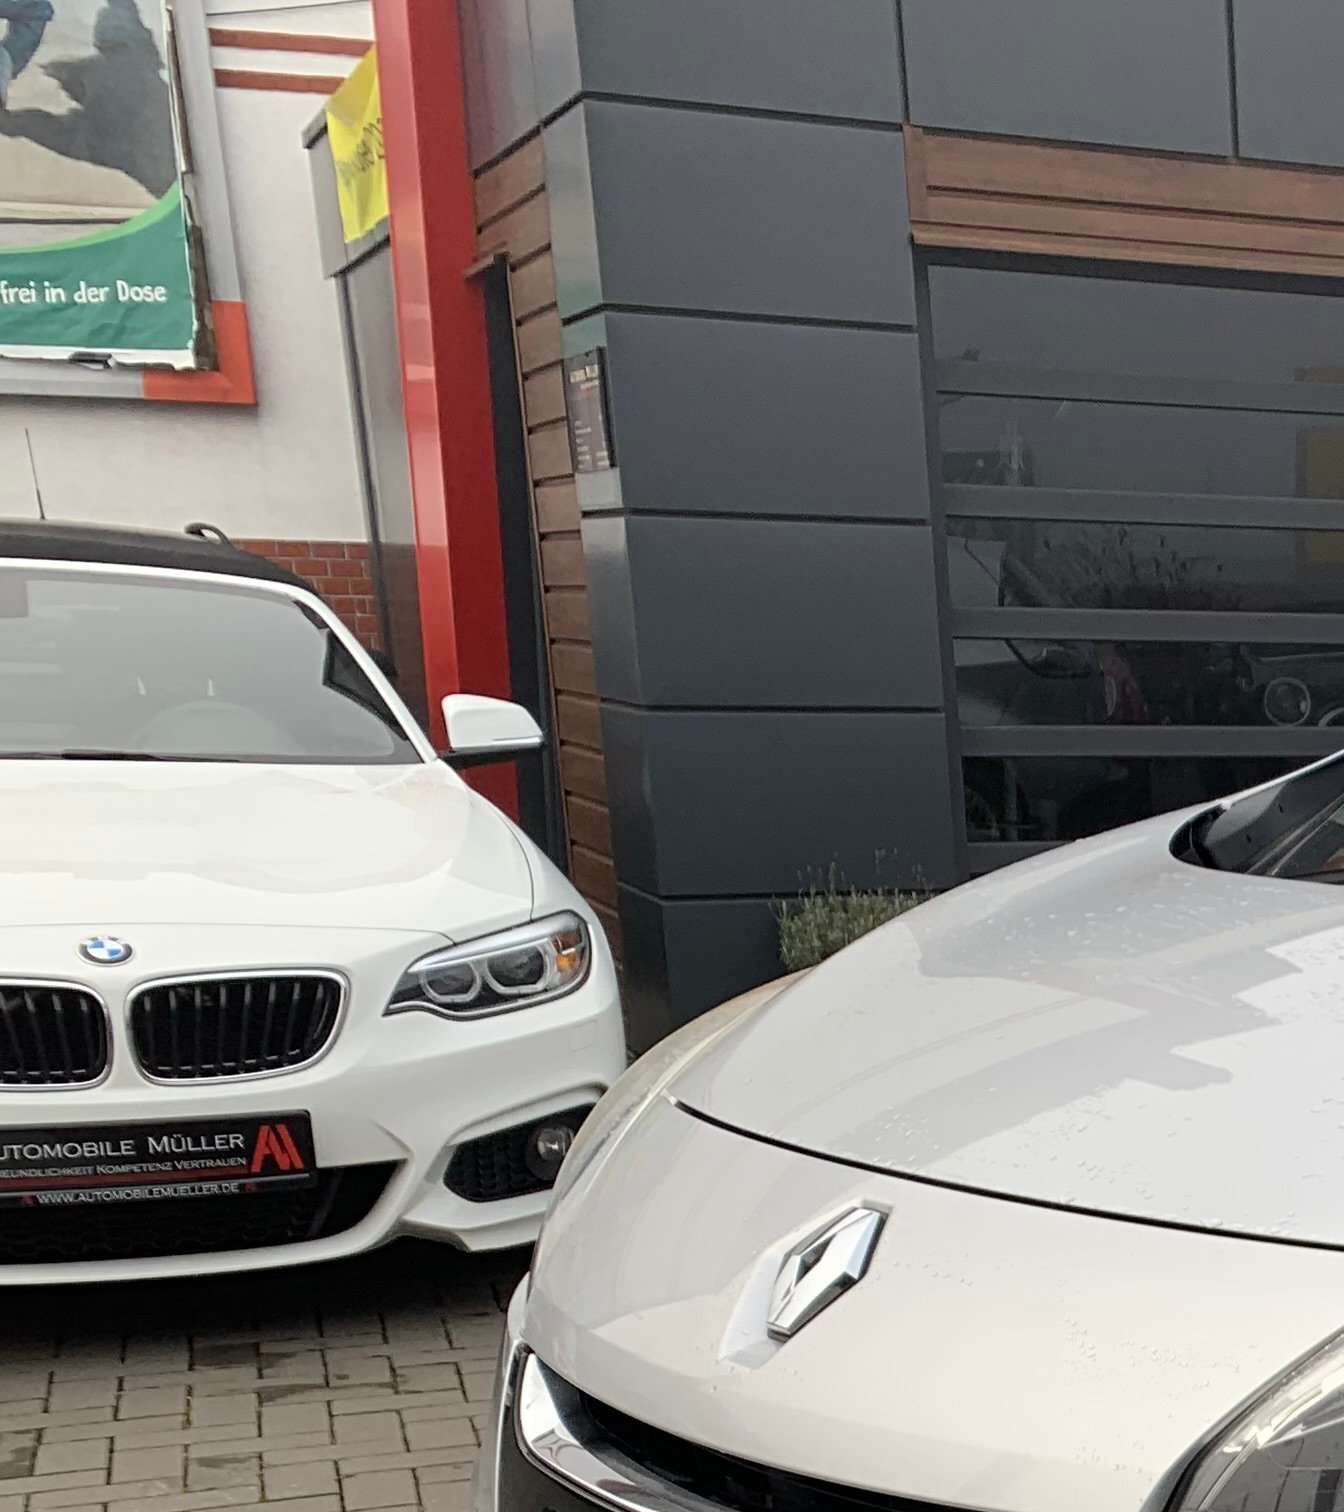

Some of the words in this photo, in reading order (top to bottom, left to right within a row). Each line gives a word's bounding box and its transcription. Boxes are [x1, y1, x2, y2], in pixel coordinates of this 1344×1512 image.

[0, 280, 36, 304] frei
[44, 280, 66, 303] in
[73, 281, 109, 304] der
[116, 280, 168, 303] Dose
[147, 1133, 246, 1155] MÜLLER
[96, 1161, 173, 1176] KOMPETENZ
[174, 1157, 247, 1171] VERTRAUEN
[36, 1182, 240, 1204] WWW.AUTOMOBILEMUELLER.DE
